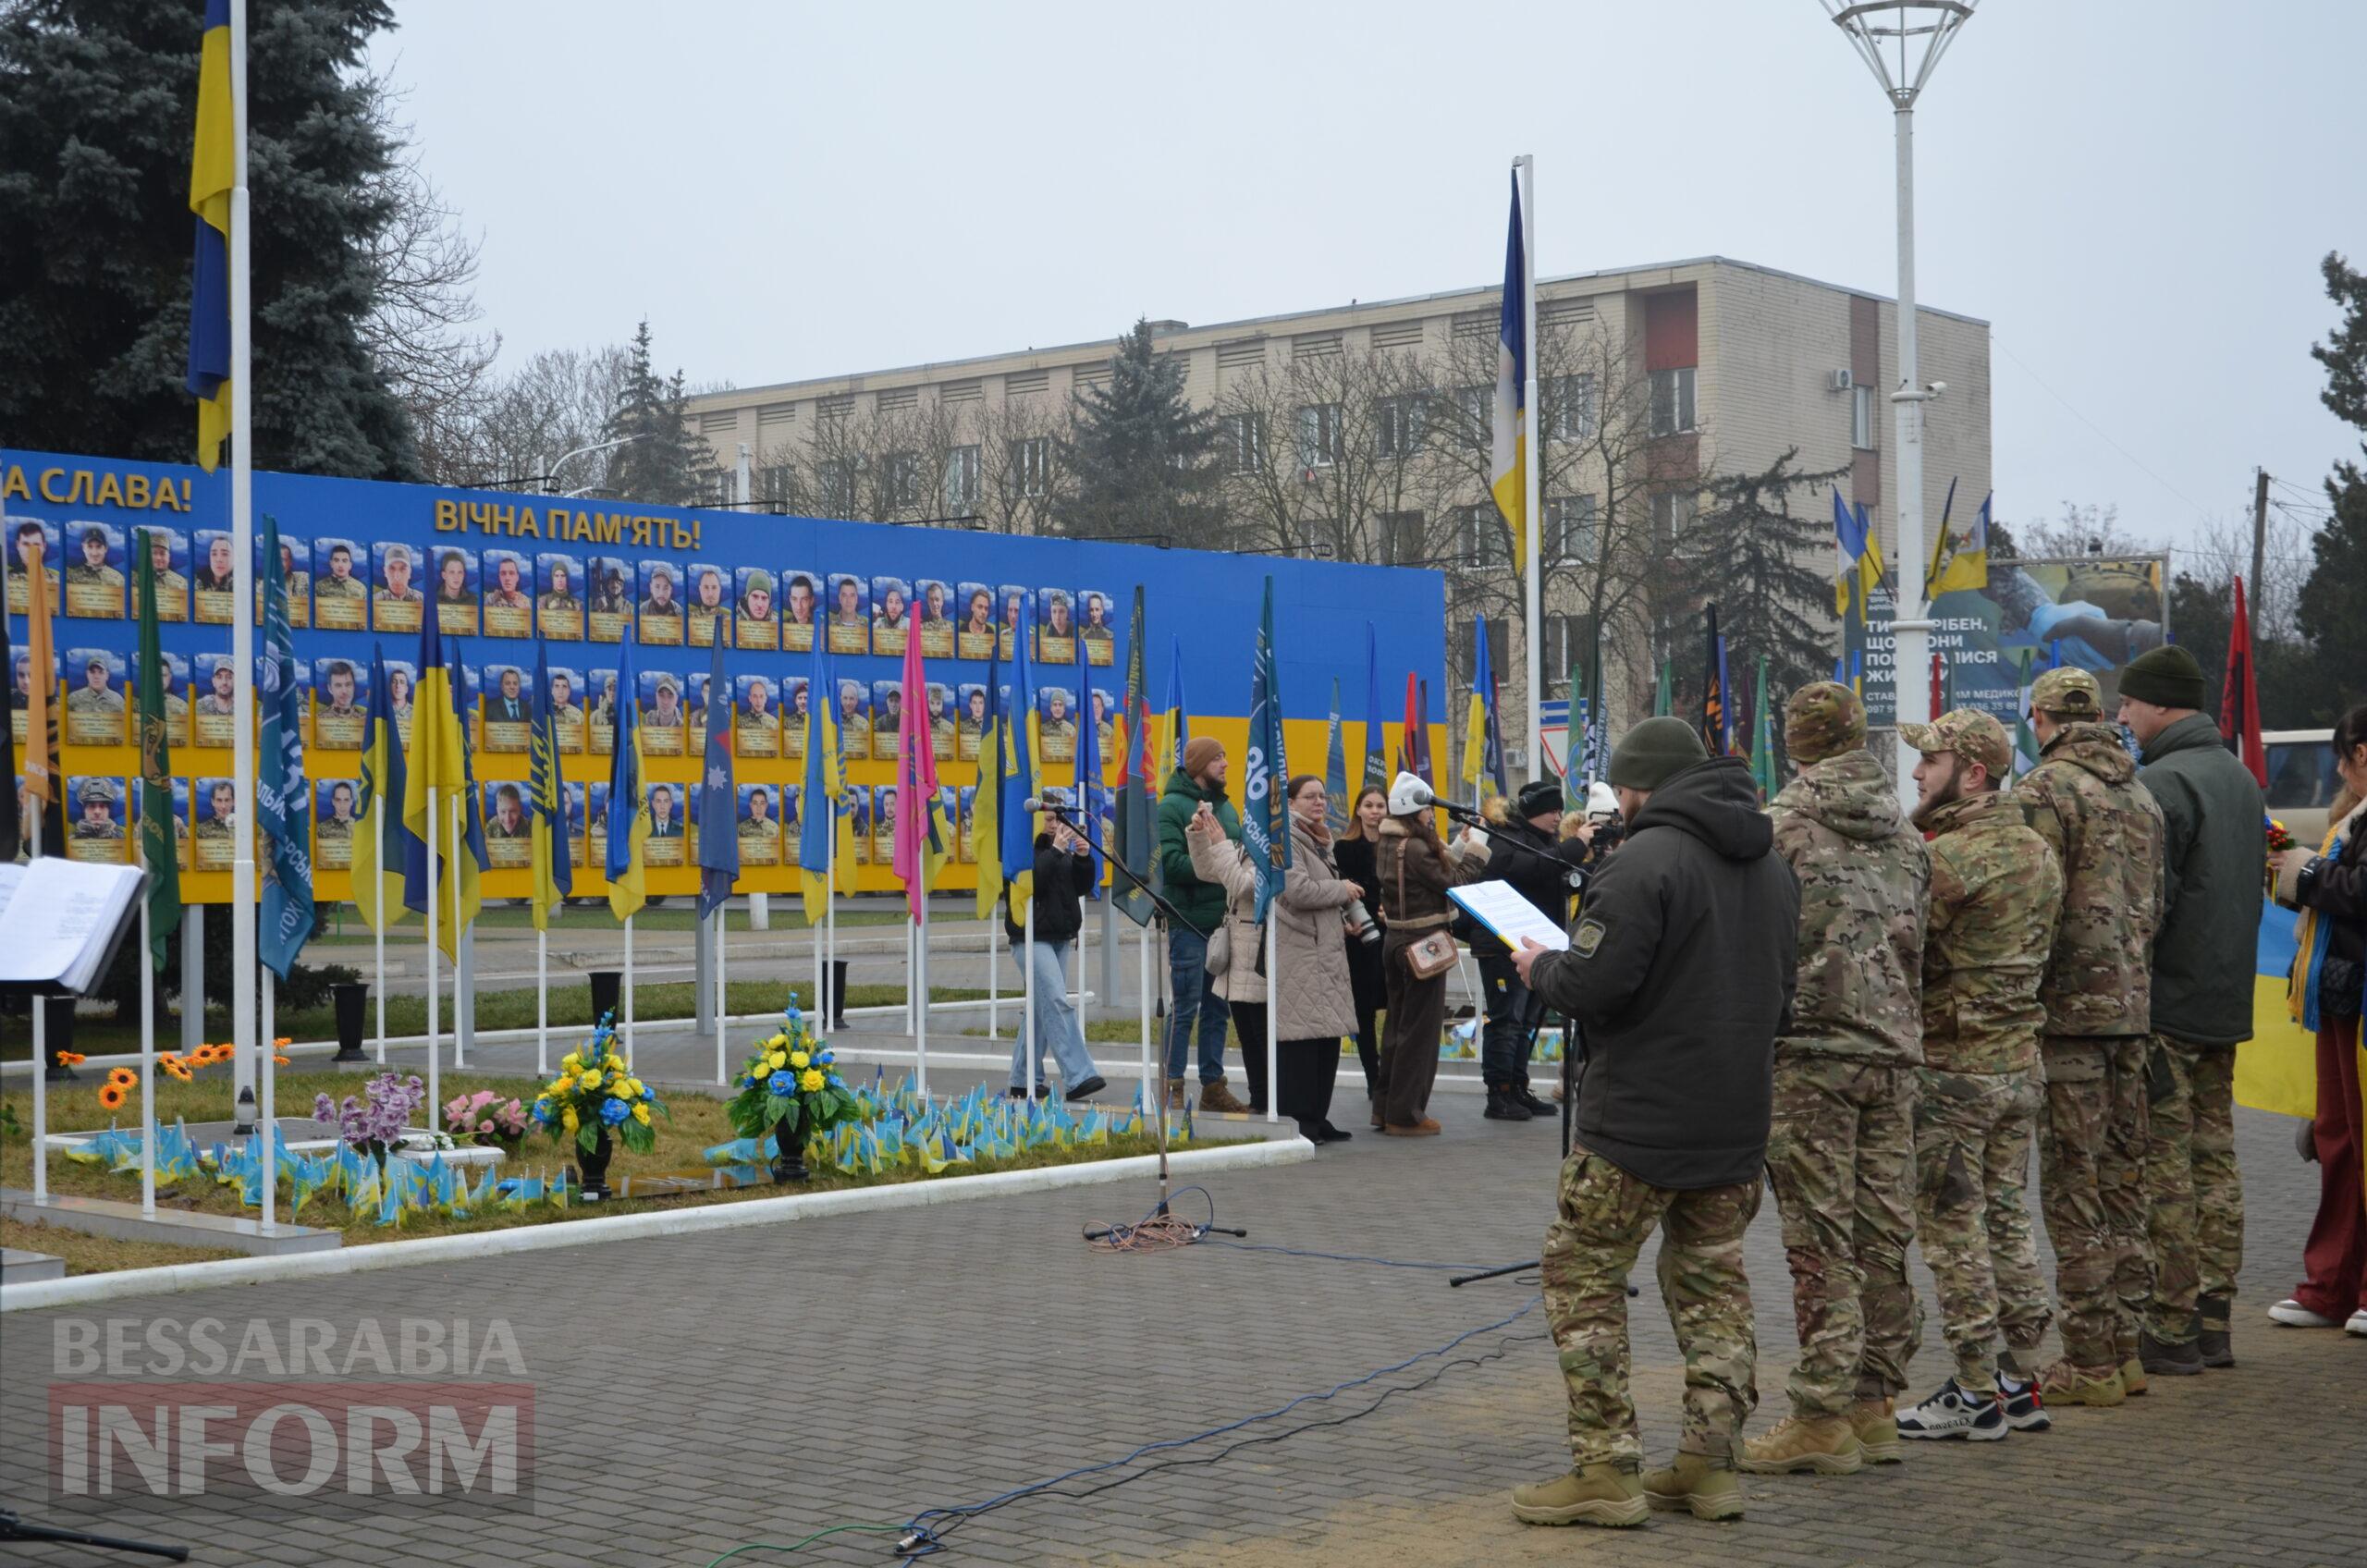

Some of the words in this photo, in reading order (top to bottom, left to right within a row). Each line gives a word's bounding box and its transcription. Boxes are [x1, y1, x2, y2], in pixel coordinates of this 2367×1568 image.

[3, 464, 32, 500] А
[39, 467, 192, 512] СЛАВА!
[435, 499, 540, 538] ВІЧНА
[547, 508, 702, 550] ПАМ'ЯТЬ!
[1866, 620, 1890, 632] ТИ
[1932, 618, 1988, 631] РІБЕН,
[1866, 637, 1897, 651] ЩО
[1927, 635, 1963, 647] ОНИ
[1973, 690, 2020, 700] МЕДИК
